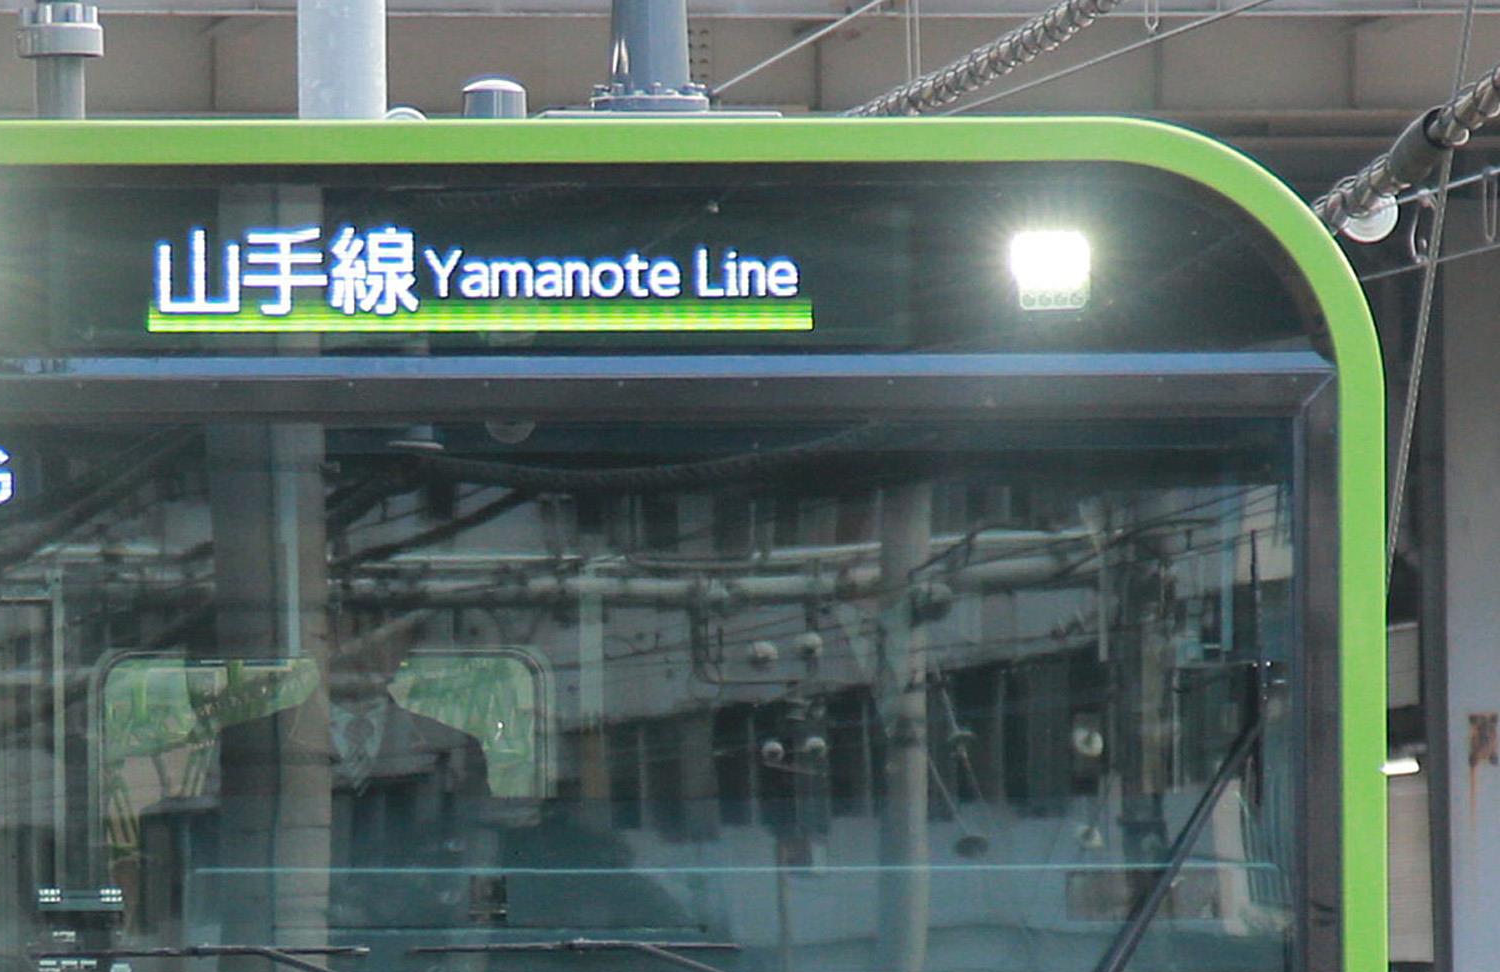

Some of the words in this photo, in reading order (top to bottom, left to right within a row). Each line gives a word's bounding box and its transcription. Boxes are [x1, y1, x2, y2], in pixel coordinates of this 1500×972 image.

[156, 226, 419, 315] 山手線
[424, 247, 682, 299] Yamanote
[698, 247, 799, 298] Line
